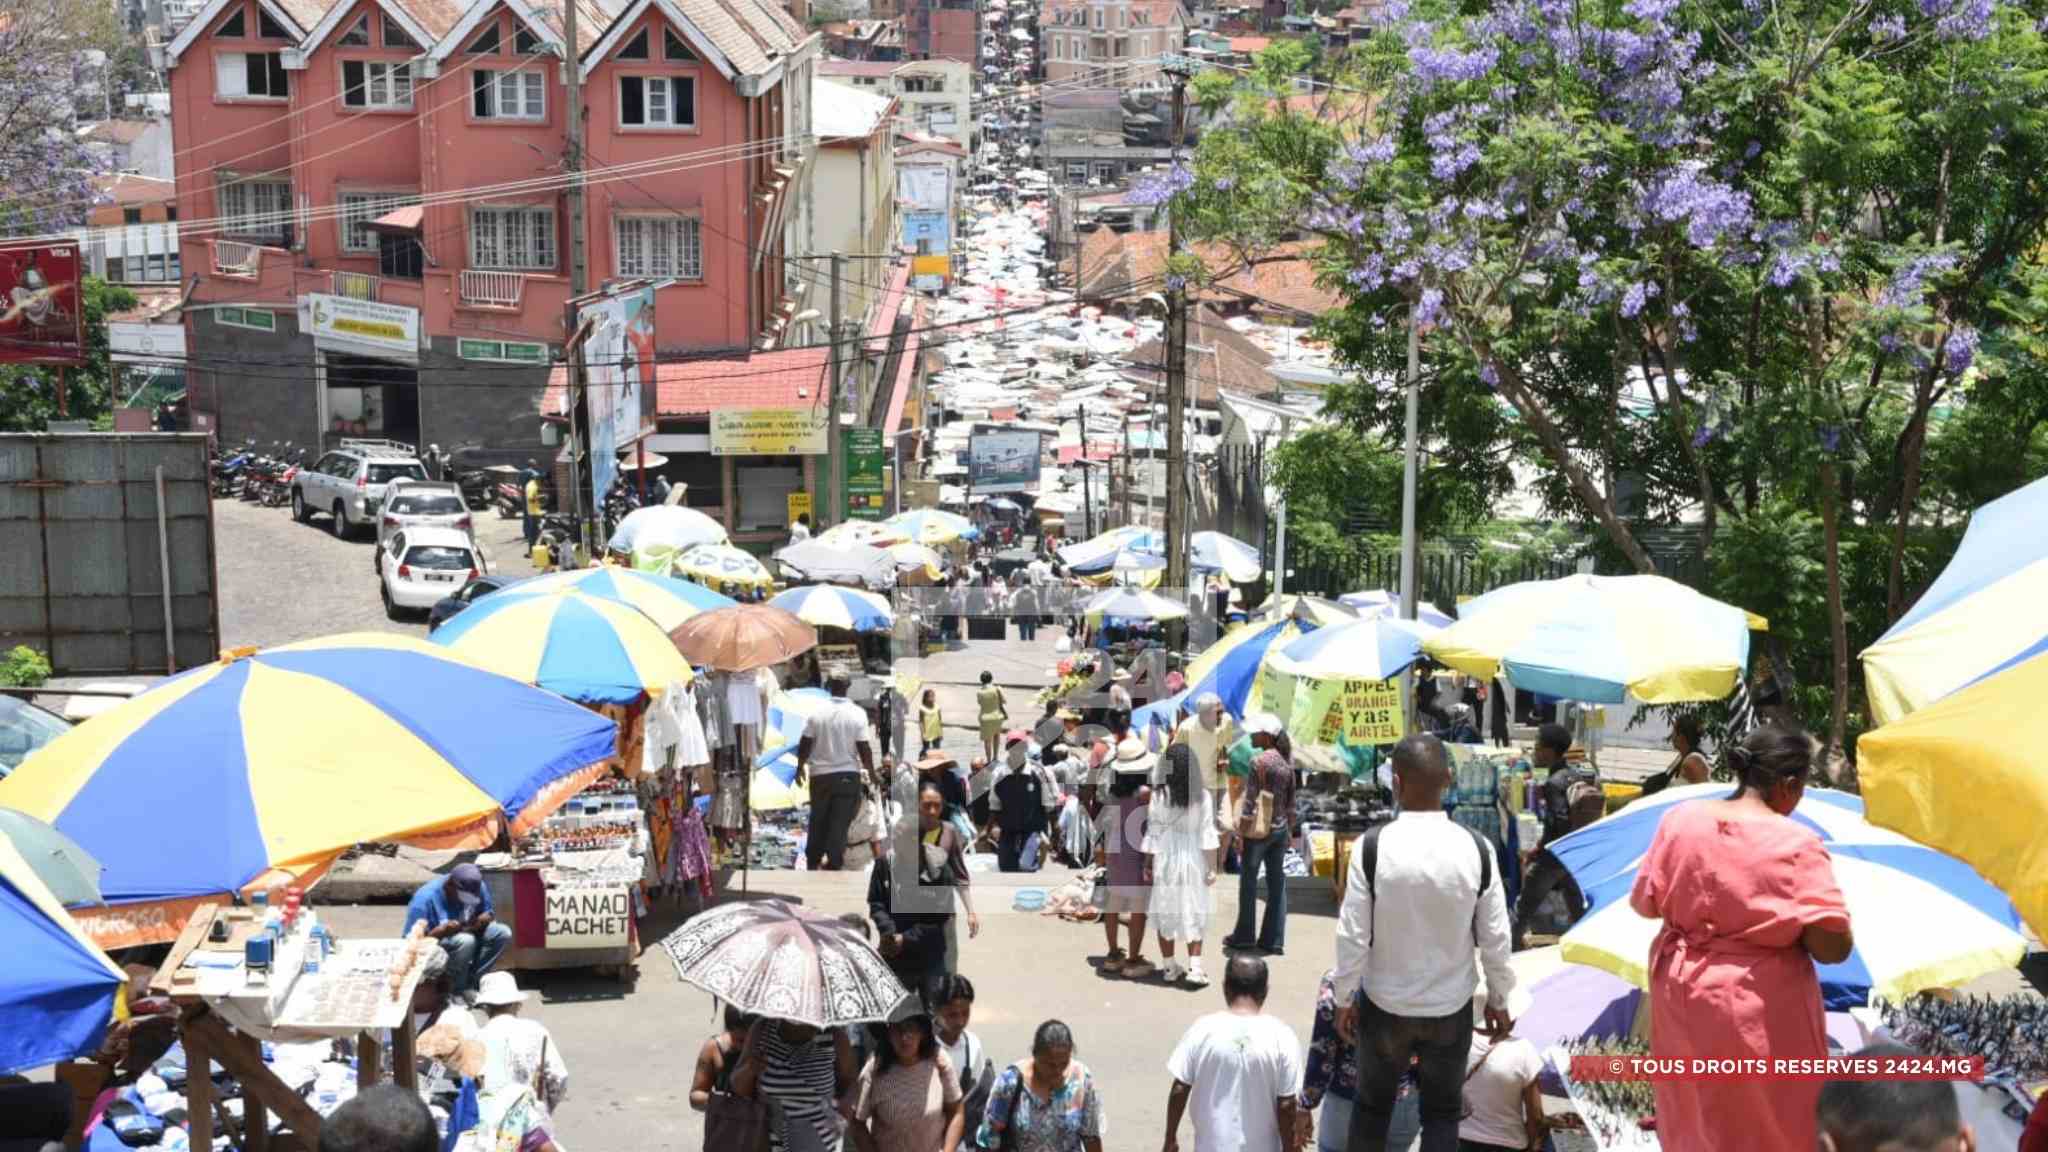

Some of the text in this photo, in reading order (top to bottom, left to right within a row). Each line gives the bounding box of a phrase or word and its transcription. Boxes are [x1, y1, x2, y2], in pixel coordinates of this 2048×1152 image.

[1344, 679, 1396, 694] APPEL
[1345, 694, 1398, 709] ORANGE
[1350, 724, 1399, 738] AIRTEL
[546, 894, 627, 915] MANAO
[545, 917, 628, 936] CACHET
